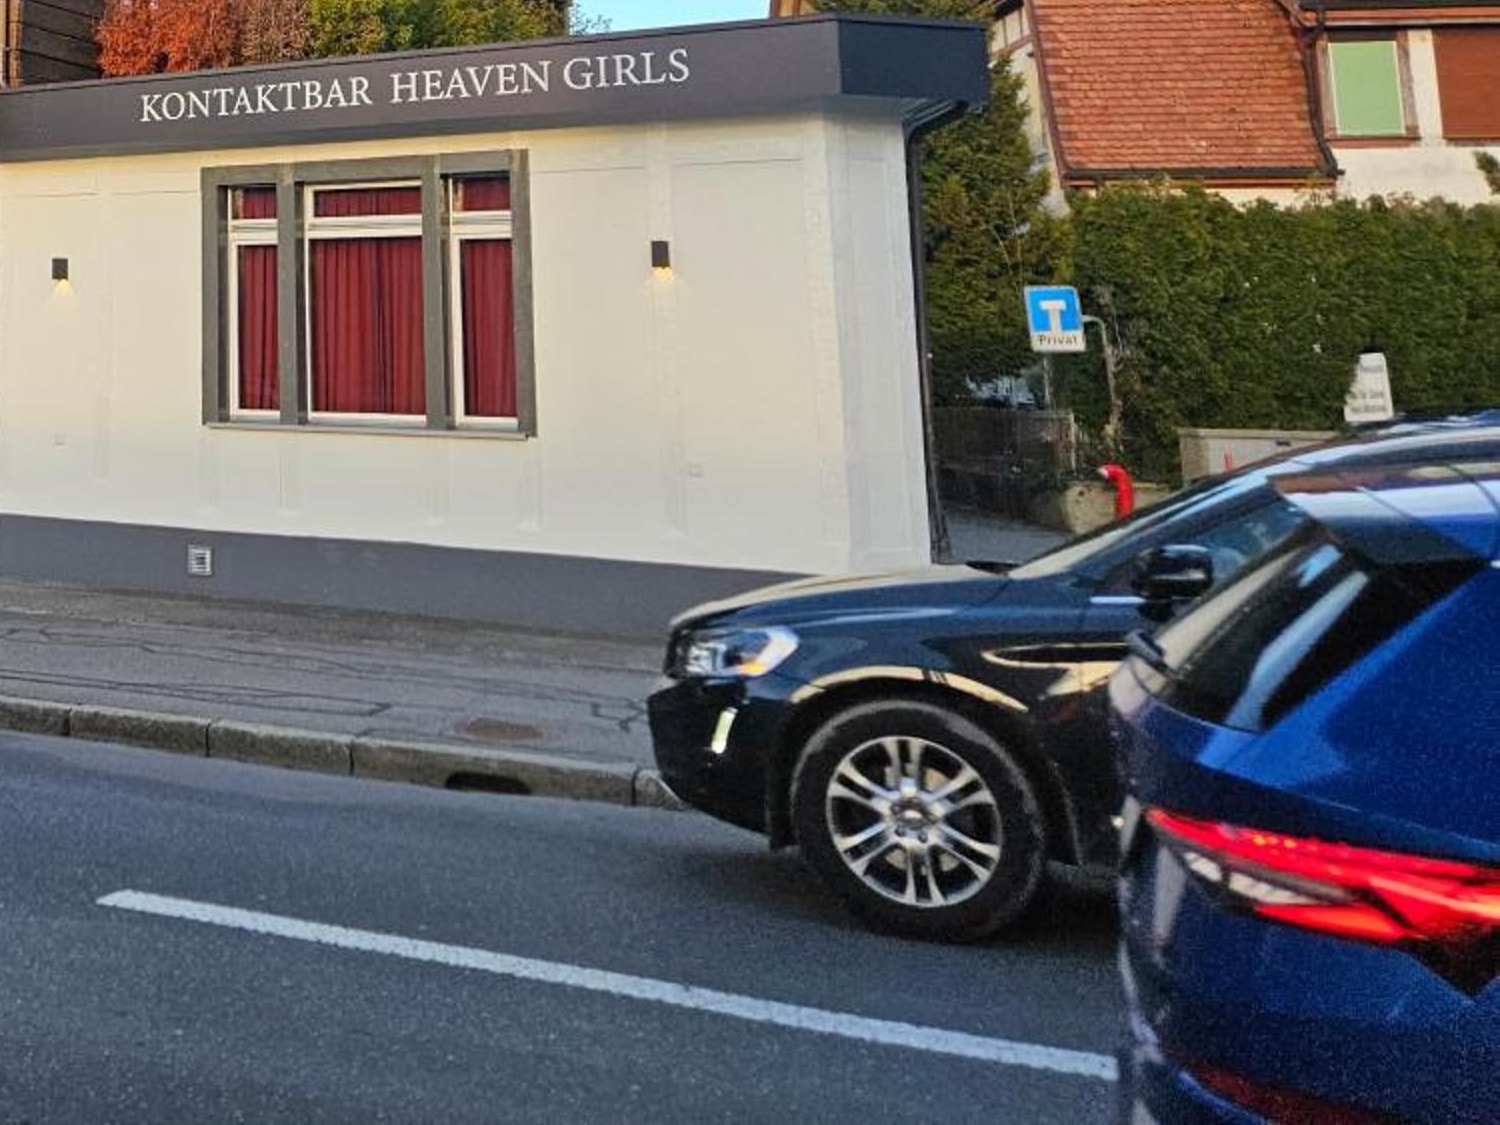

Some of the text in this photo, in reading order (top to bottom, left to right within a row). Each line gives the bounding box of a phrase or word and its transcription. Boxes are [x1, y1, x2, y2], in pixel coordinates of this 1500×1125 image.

[140, 48, 689, 123] KONTAKTBAR HEAVEN GIRLS
[1038, 334, 1078, 345] Privat
